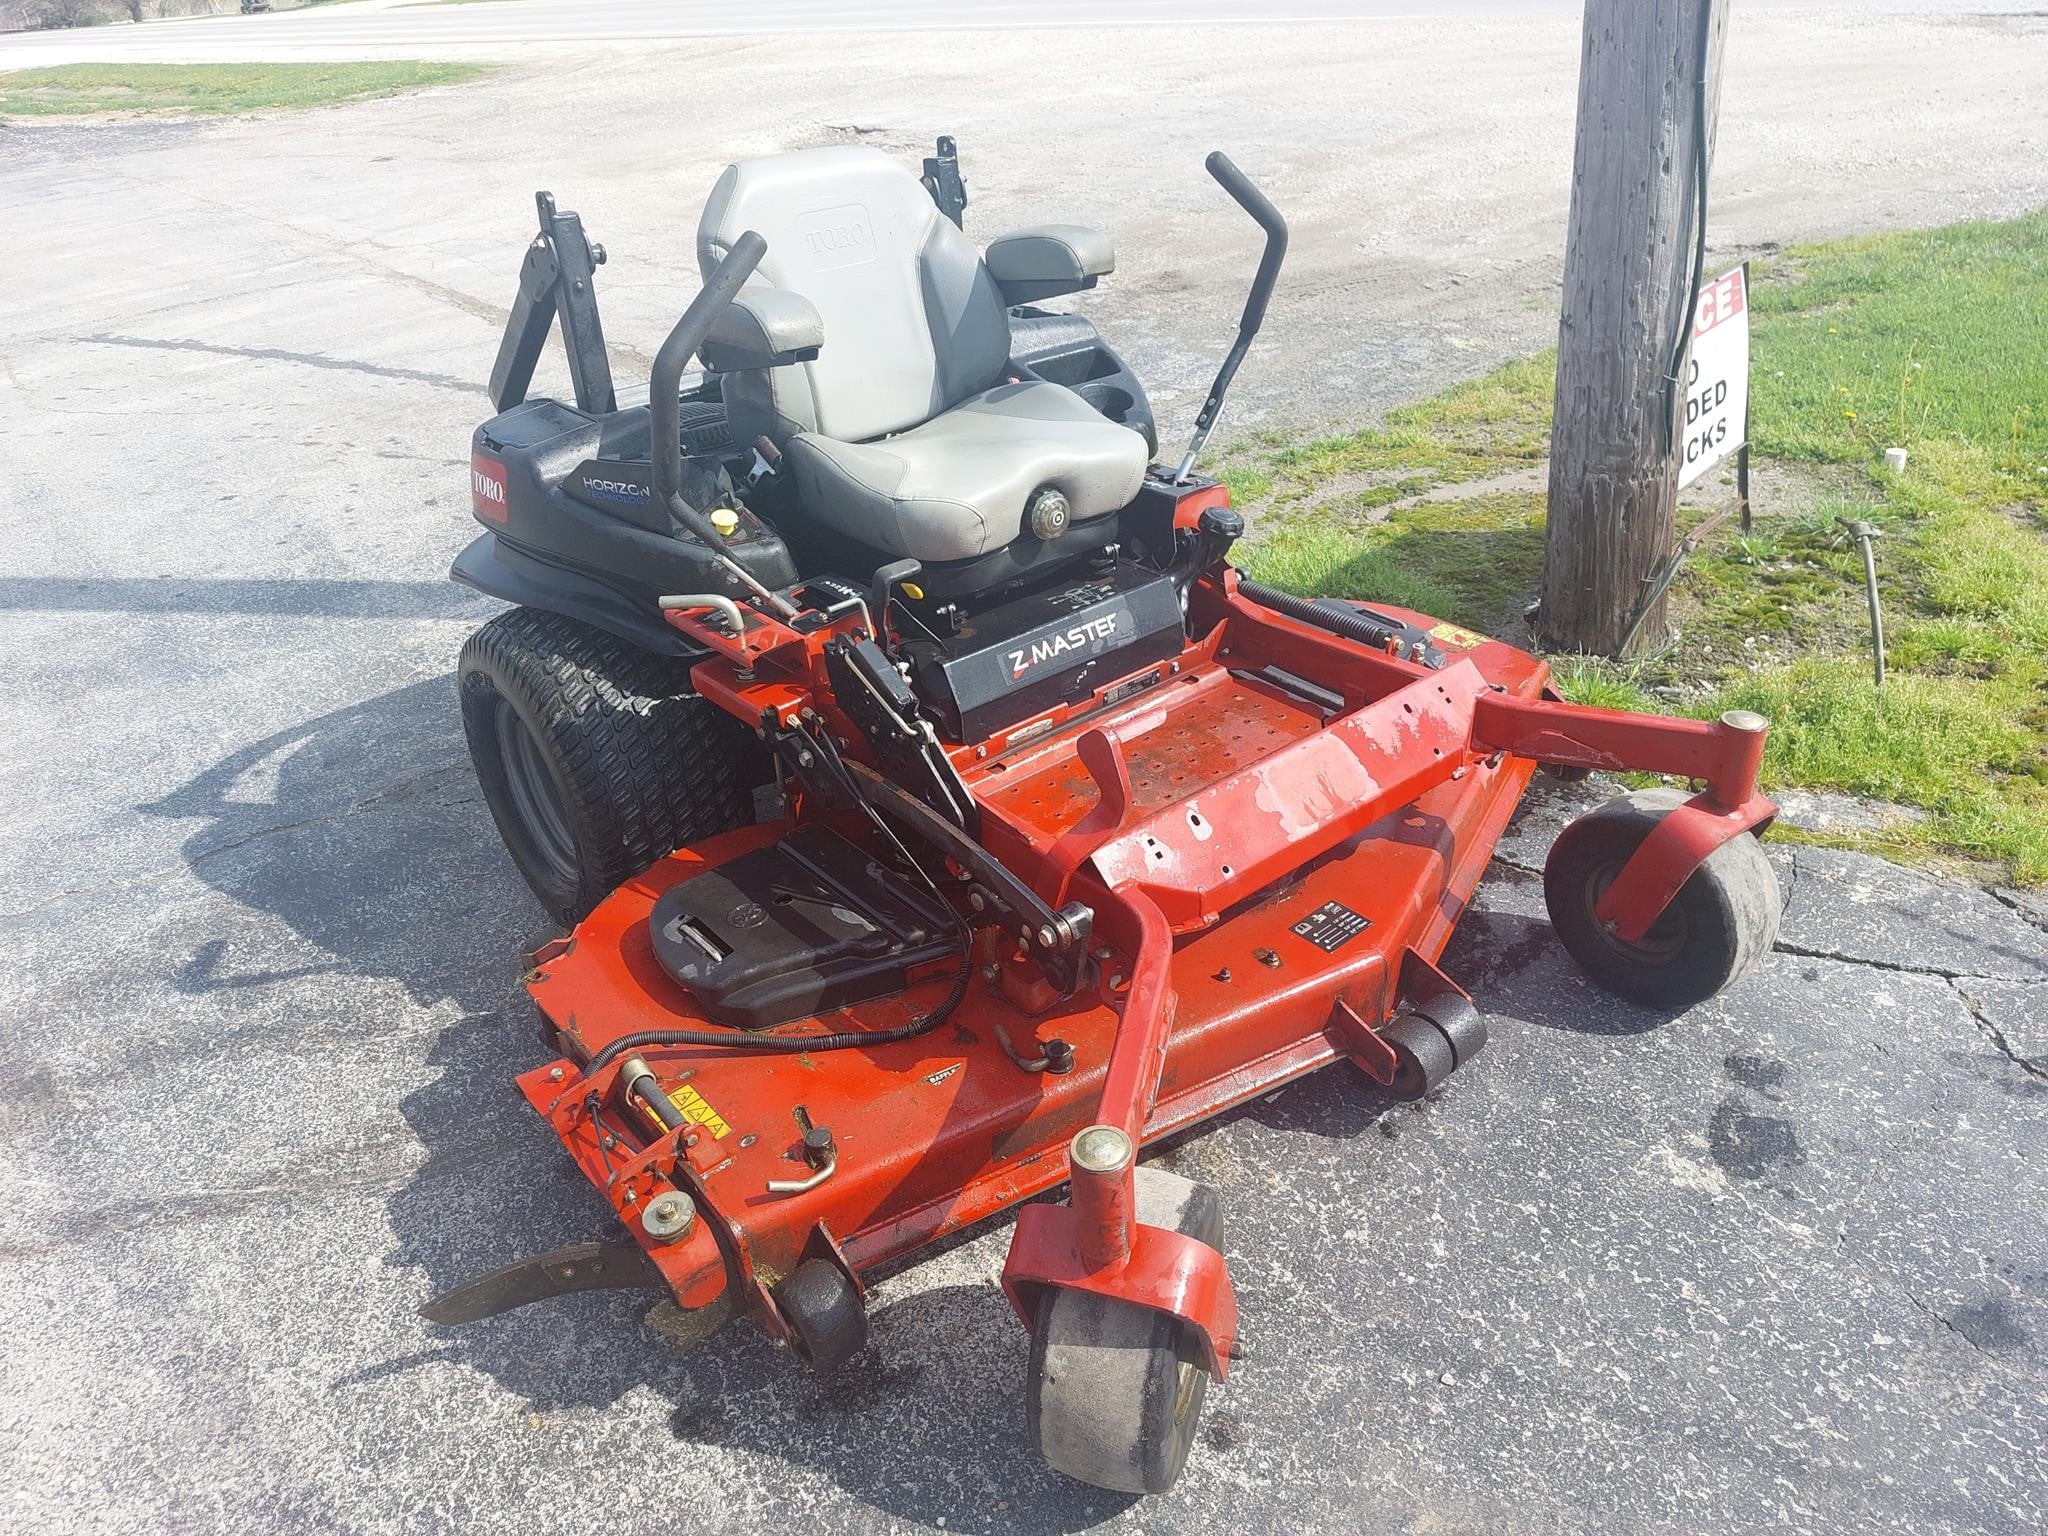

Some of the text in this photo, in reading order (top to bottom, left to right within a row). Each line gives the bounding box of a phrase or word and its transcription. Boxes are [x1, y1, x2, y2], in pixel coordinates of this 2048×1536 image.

[806, 223, 865, 254] TORO
[1696, 279, 1733, 331] CE
[1687, 379, 1727, 426] DED
[1681, 417, 1726, 470] CKS
[473, 470, 504, 503] TORO
[582, 476, 650, 497] HORIZON
[584, 489, 651, 505] TECHNOLOGY
